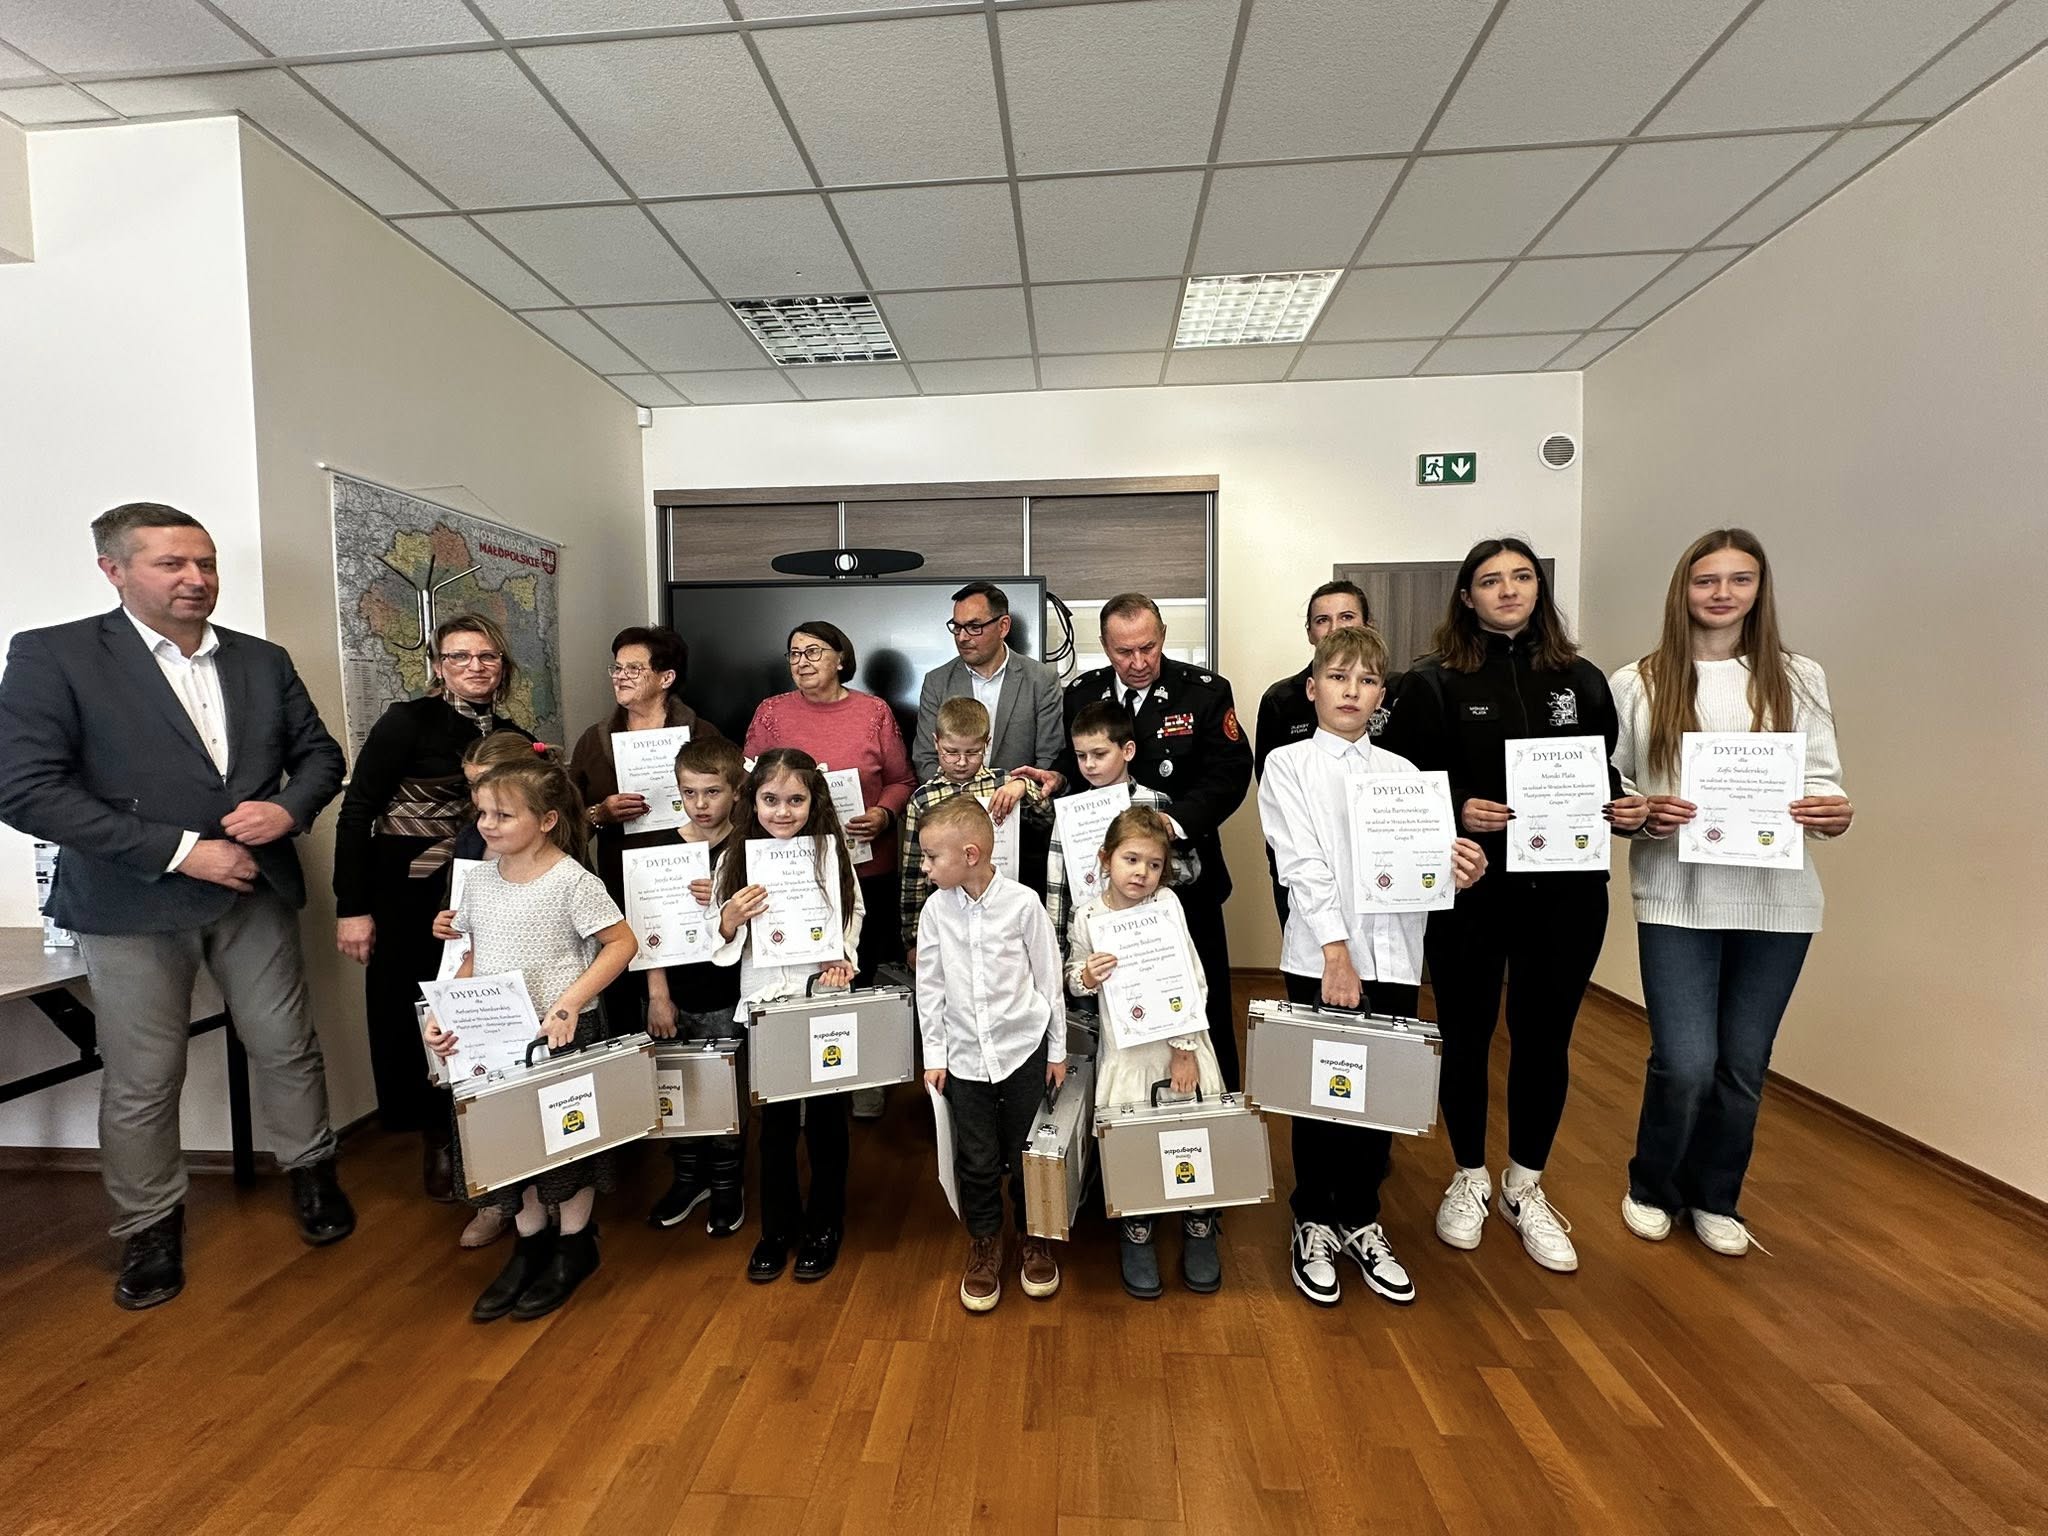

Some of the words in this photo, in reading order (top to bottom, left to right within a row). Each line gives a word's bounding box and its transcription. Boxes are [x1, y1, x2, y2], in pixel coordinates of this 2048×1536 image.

[480, 543, 540, 567] MAŁOPOLSKIE
[633, 738, 672, 749] DYPLOM
[1532, 751, 1583, 762] DYPLOM
[1713, 746, 1774, 756] DYPLOM
[1373, 785, 1424, 796] DYPLOM
[1074, 798, 1111, 813] DYPLOM
[770, 848, 816, 860] DYPLOM
[646, 856, 690, 868] DYPLOM
[1113, 916, 1158, 934] DYPLOM
[450, 987, 501, 1000] DYPLOM
[814, 1030, 850, 1040] Podegrodzie
[1320, 1059, 1363, 1071] Podegrodzie
[549, 1091, 592, 1109] Podegrodzie
[1164, 1146, 1202, 1155] Podegrodzie
